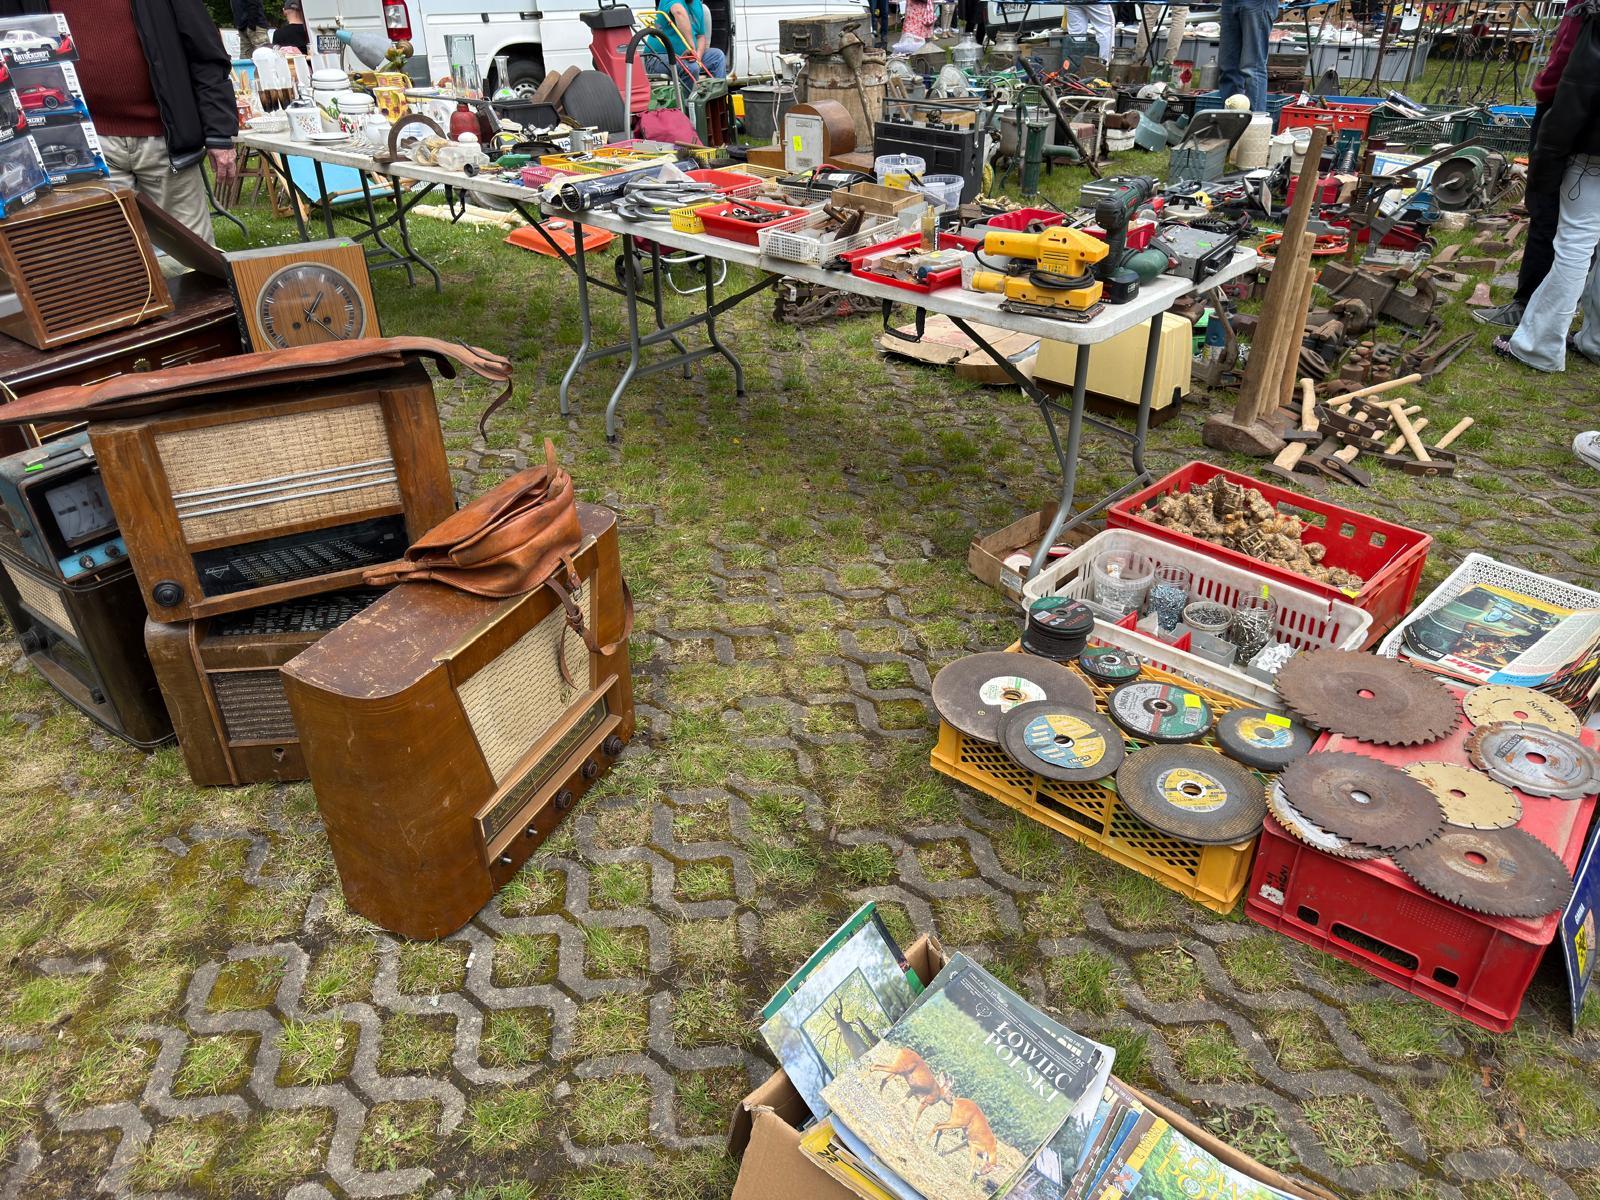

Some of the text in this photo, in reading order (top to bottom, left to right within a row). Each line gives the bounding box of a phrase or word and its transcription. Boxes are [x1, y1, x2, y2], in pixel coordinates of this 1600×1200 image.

[983, 1031, 1059, 1103] POLSKI
[995, 1021, 1073, 1090] ŁOWIEC
[1070, 1054, 1085, 1068] 7/95
